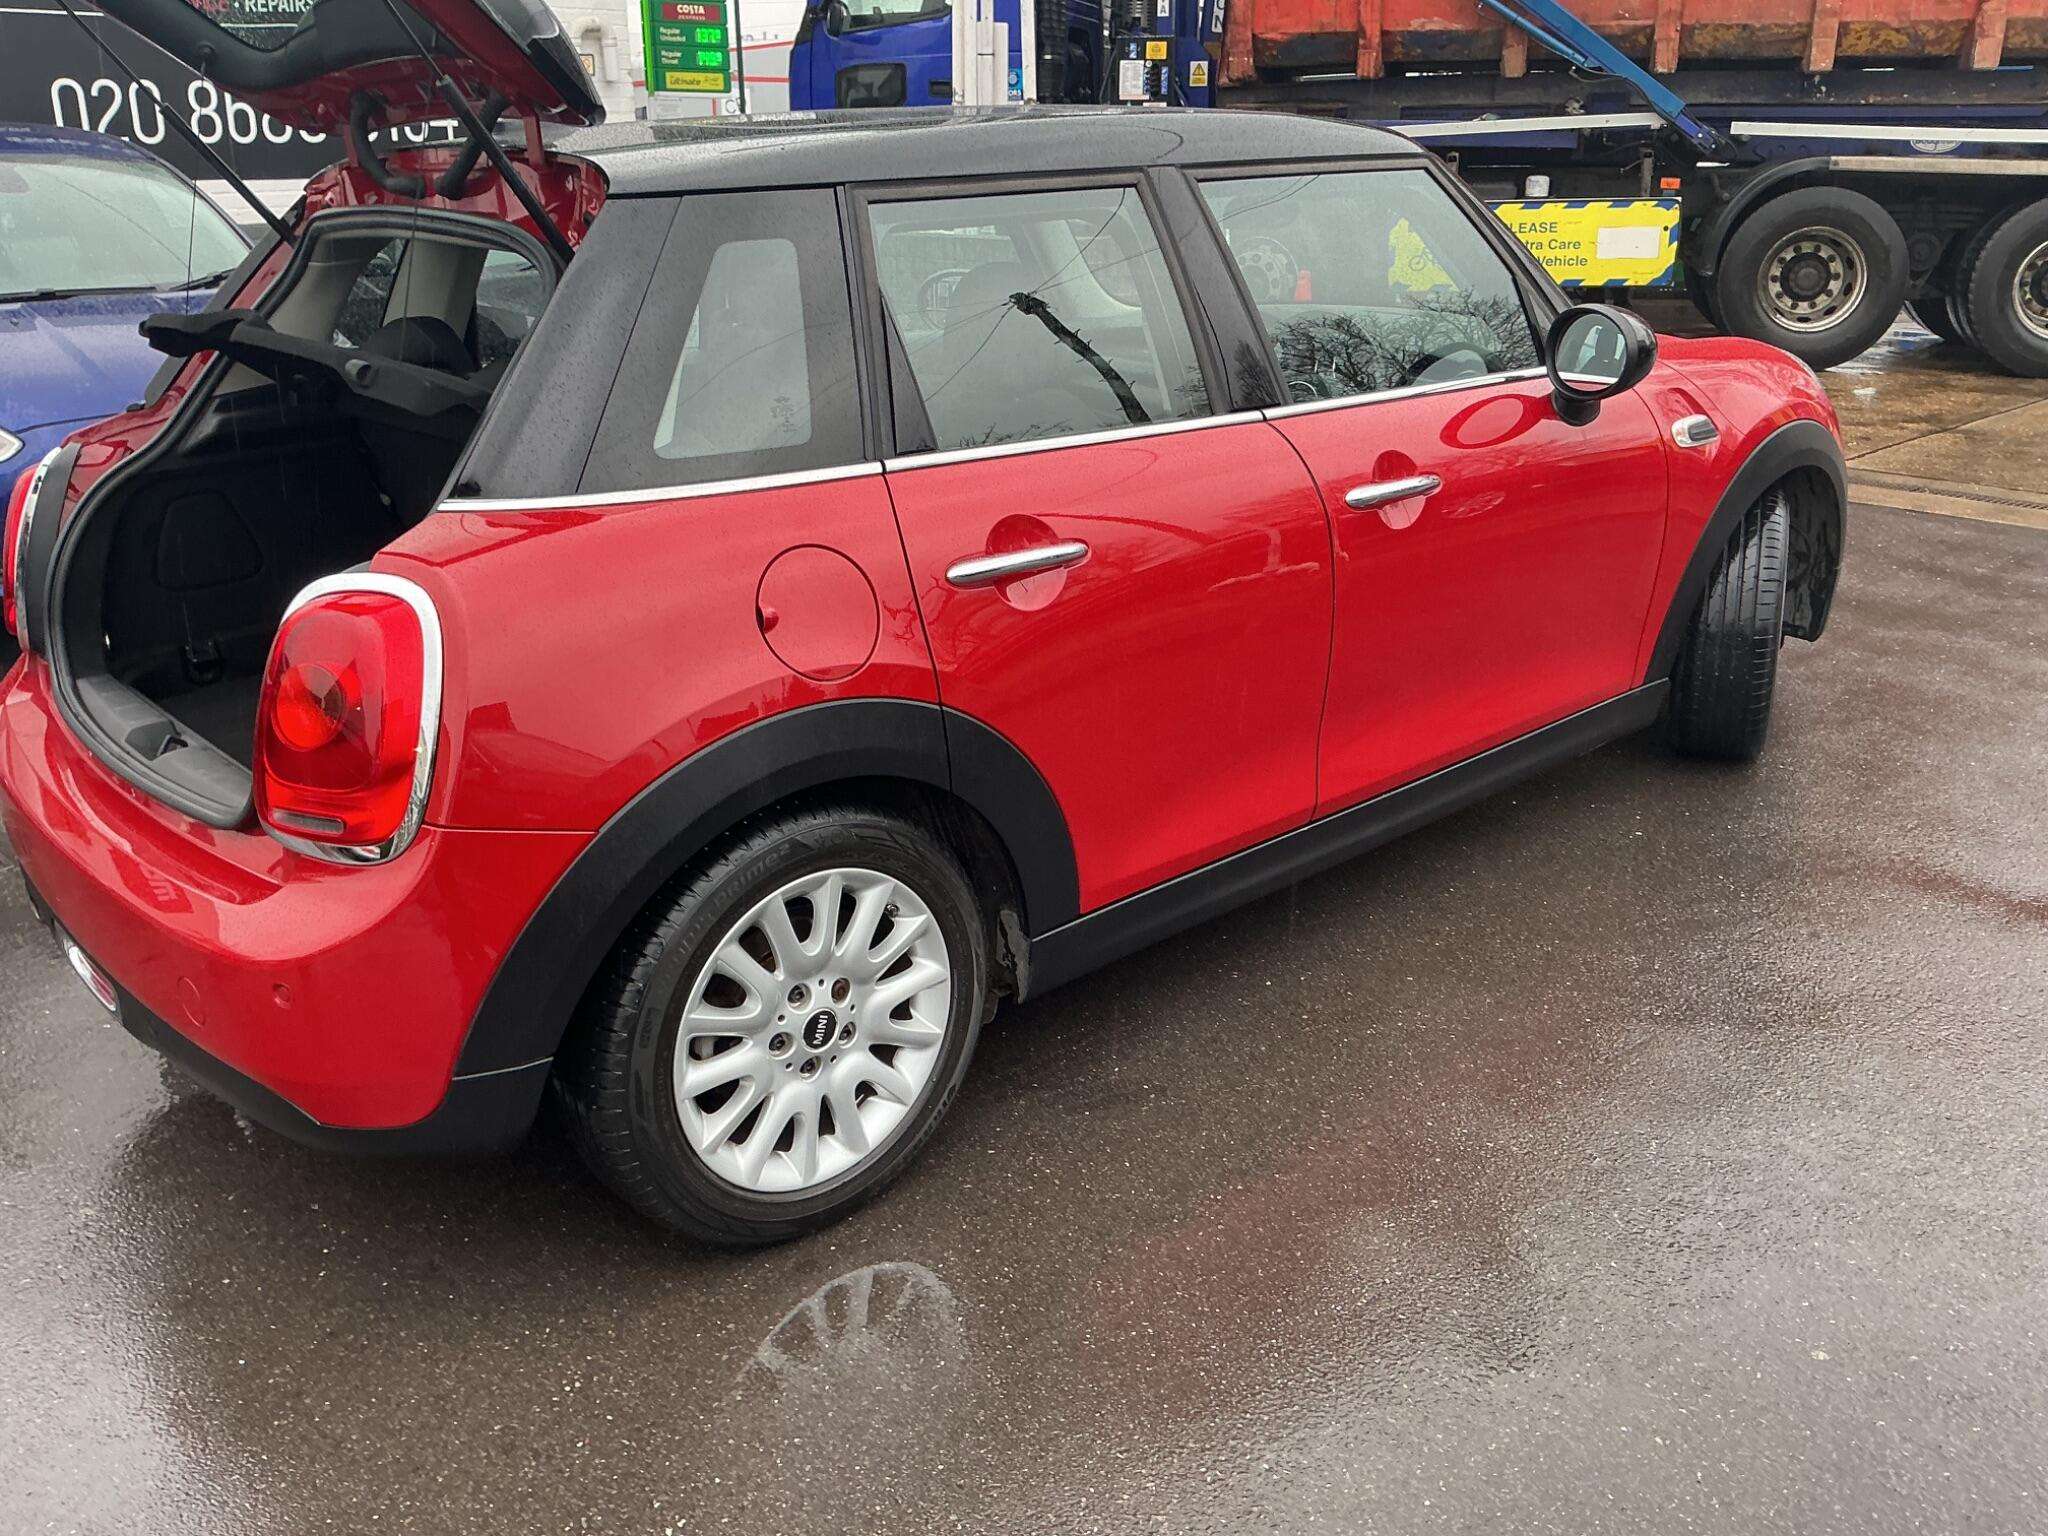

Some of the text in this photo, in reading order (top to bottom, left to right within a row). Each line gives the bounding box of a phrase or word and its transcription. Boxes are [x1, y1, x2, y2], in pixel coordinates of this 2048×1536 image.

[677, 4, 705, 14] COSTA
[50, 77, 166, 145] 020
[1548, 238, 1581, 251] Care
[812, 1014, 828, 1045] MINI
